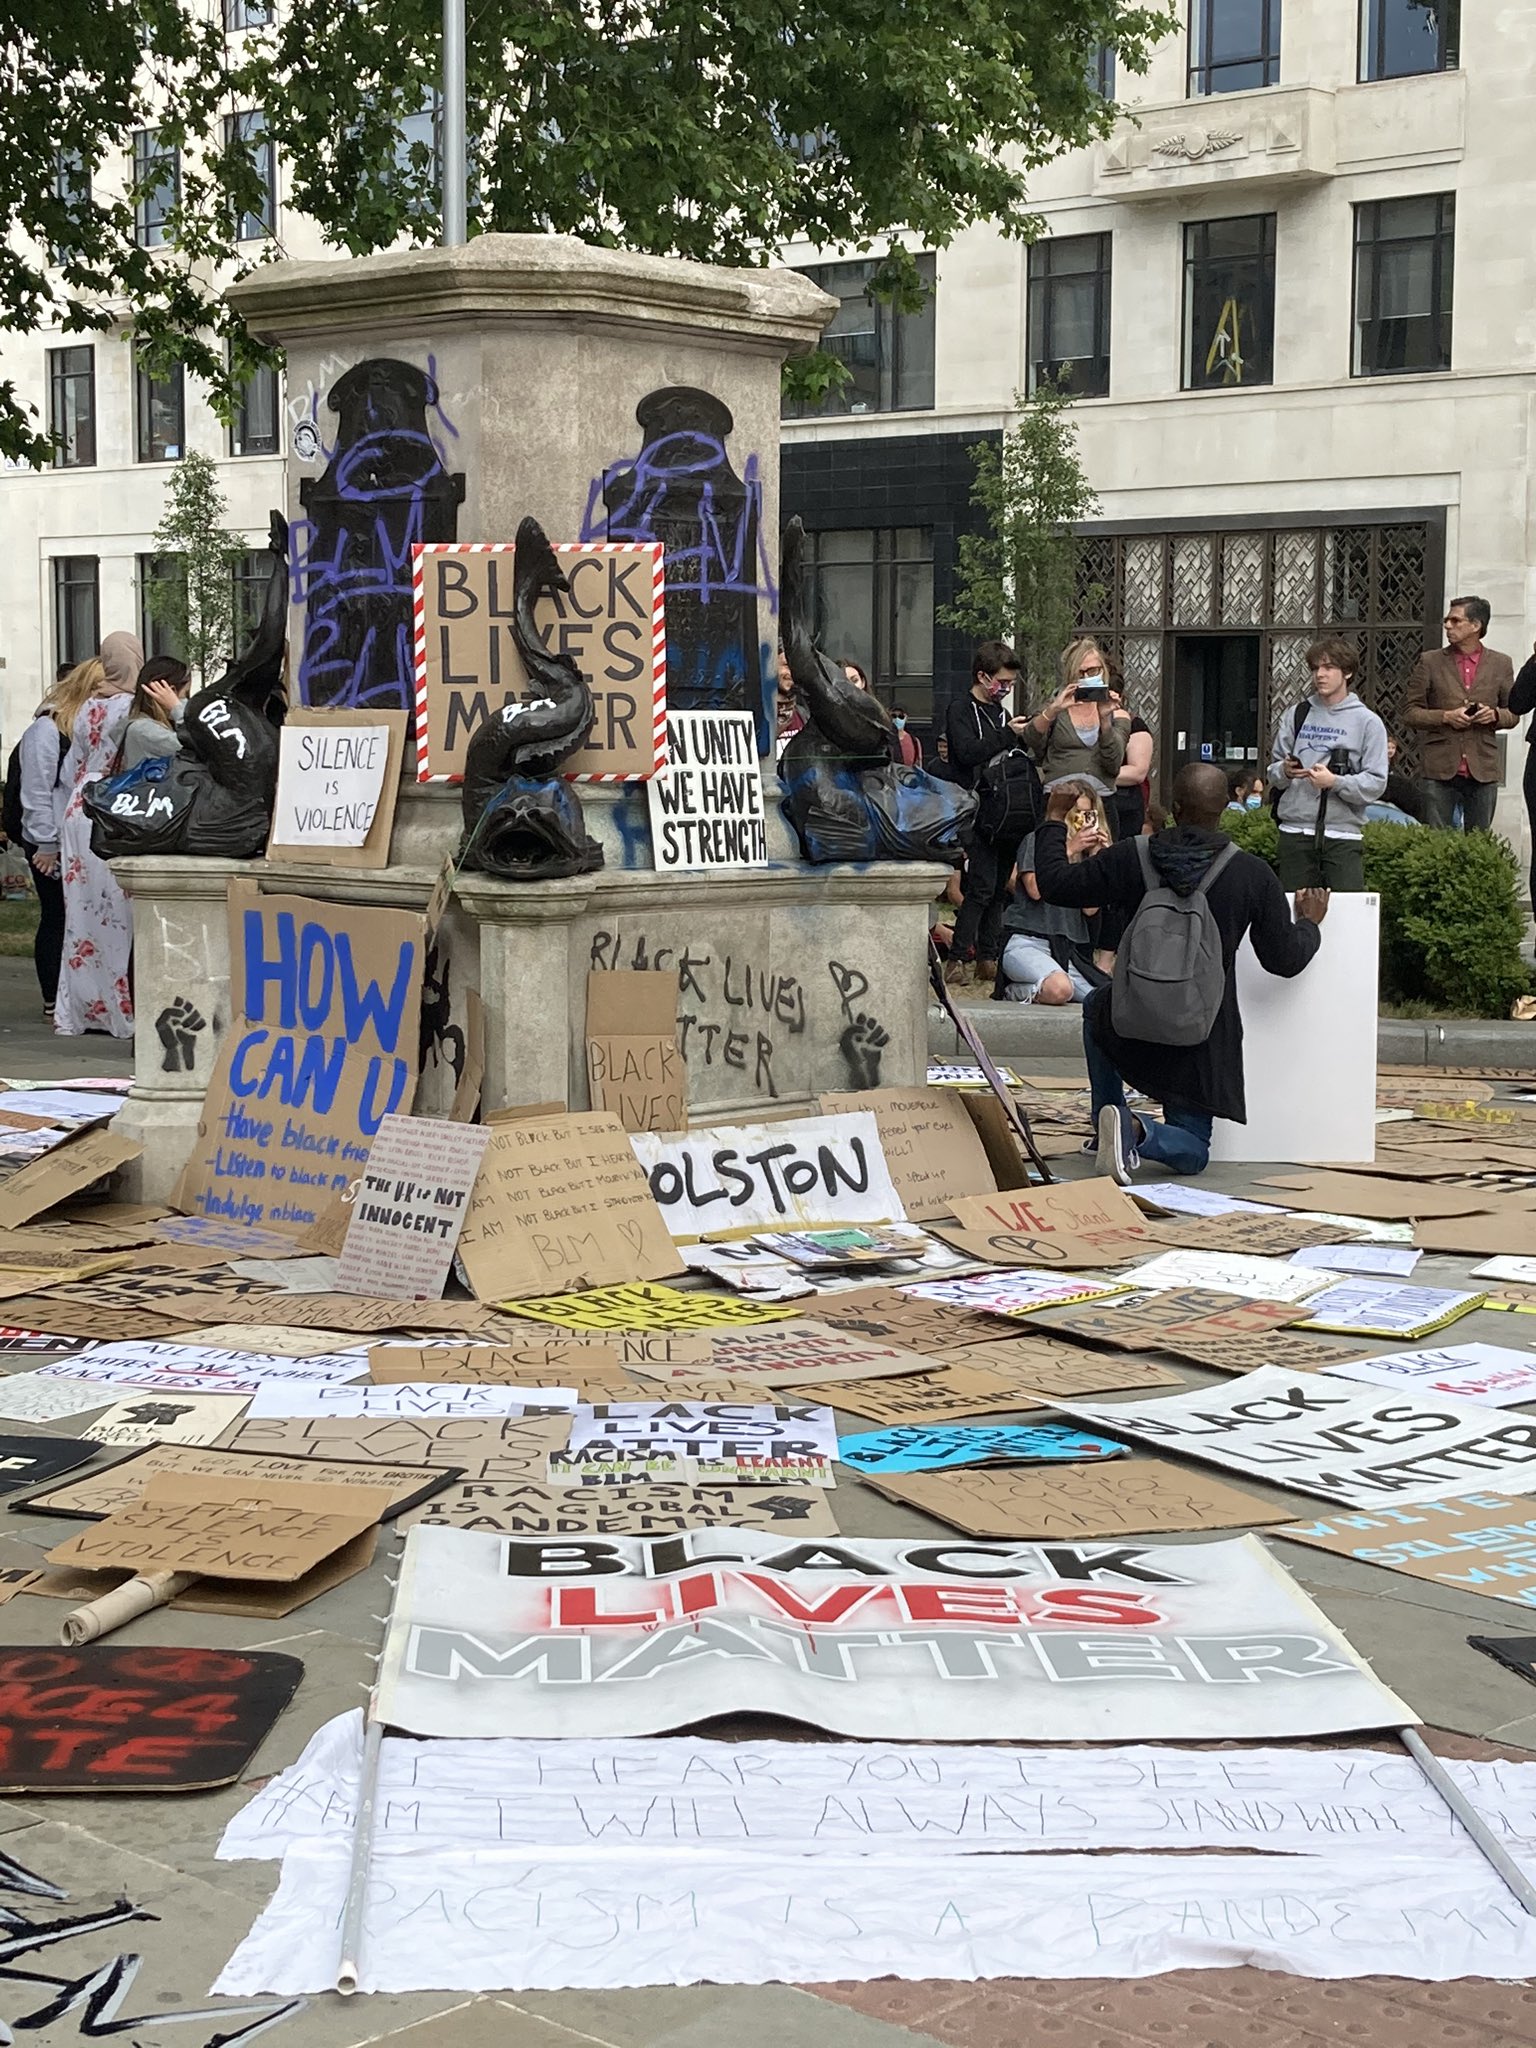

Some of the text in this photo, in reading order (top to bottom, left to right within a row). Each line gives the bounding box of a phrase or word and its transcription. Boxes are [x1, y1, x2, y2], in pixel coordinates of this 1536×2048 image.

[297, 734, 381, 771] SILENCE
[690, 718, 753, 766] UNITY
[325, 780, 339, 796] IS
[657, 771, 760, 815] WE HAVE
[294, 801, 374, 833] VIOLENCE
[662, 819, 768, 866] STRENGTH
[243, 909, 415, 1054] HOW
[724, 955, 806, 1034] LIVES
[590, 1041, 676, 1083] BLACK
[676, 1013, 780, 1099] TTER
[228, 1029, 409, 1136] CAN U
[281, 1118, 341, 1161] black
[552, 1128, 572, 1142] BUT
[577, 1125, 587, 1137] I
[911, 1121, 932, 1135] your
[289, 1164, 331, 1189] black
[497, 1167, 527, 1183] NOT
[528, 1163, 560, 1178] BLACK
[565, 1158, 583, 1171] BUT
[586, 1155, 599, 1168] I
[642, 1136, 869, 1214] OLSTON
[365, 1175, 392, 1193] THE
[416, 1188, 431, 1200] IS
[434, 1187, 466, 1208] NOT
[472, 1194, 496, 1213] AM
[506, 1188, 532, 1203] NOT
[539, 1184, 567, 1200] BLACK
[567, 1180, 584, 1195] BUT
[359, 1203, 454, 1239] INNOCENT
[460, 1228, 476, 1246] I
[482, 1220, 505, 1240] AM
[515, 1212, 539, 1229] NOT
[543, 1208, 571, 1223] BLACK
[573, 1204, 588, 1217] BUT
[590, 1201, 600, 1212] I
[985, 1196, 1114, 1232] WE Stand
[532, 1232, 606, 1273] BLM
[516, 1286, 668, 1317] BLACK
[569, 1298, 728, 1329] LIVES
[711, 1329, 823, 1347] HAVE
[66, 1355, 345, 1381] MATTER ONLY WHEN
[126, 1344, 360, 1369] ALL LIVES WILL
[418, 1349, 571, 1370] BLACK
[737, 1348, 845, 1363] KILL
[1364, 1351, 1472, 1375] BLACK
[34, 1365, 213, 1387] BLACK LIVES
[441, 1368, 572, 1378] LIVES
[603, 1378, 765, 1398] BLACK
[796, 1375, 944, 1393] THE UK
[319, 1384, 495, 1402] BLACK
[362, 1400, 506, 1415] LIVES
[855, 1390, 902, 1400] IS
[522, 1402, 820, 1422] BLACK
[1087, 1386, 1352, 1437] BLACK
[236, 1417, 550, 1442] BLACK
[604, 1420, 786, 1437] LIVES
[1203, 1406, 1462, 1463] LIVES
[548, 1448, 678, 1465] RACISM
[735, 1453, 826, 1468] LEARNT
[566, 1438, 829, 1459] ATTER
[843, 1426, 940, 1463] BLACK
[145, 1459, 180, 1470] BUT
[190, 1465, 216, 1474] WE
[221, 1468, 253, 1477] CAN
[261, 1472, 305, 1481] NEVER
[199, 1457, 238, 1466] GOT
[250, 1458, 309, 1472] LOVE
[318, 1467, 347, 1476] FOR
[352, 1470, 378, 1478] MY
[580, 1460, 632, 1474] CAN
[580, 1471, 653, 1486] BLM
[425, 1500, 744, 1517] IS A GLOBAL
[461, 1484, 735, 1503] RACISM
[112, 1512, 333, 1541] SILENCE
[141, 1498, 343, 1528] WHITE
[1279, 1495, 1514, 1538] WHITE
[74, 1538, 301, 1570] VIOLENCE
[169, 1531, 225, 1547] IS
[500, 1533, 1196, 1586] BLACK
[546, 1570, 1172, 1630] LIVES
[402, 1624, 1364, 1687] MATTER
[536, 1753, 784, 1786] HEAR
[999, 1755, 1062, 1788] I
[1095, 1757, 1284, 1791] SEE
[571, 1793, 1098, 1838] WILL ALWAYS
[783, 1894, 864, 1944] IS
[934, 1899, 971, 1937] A
